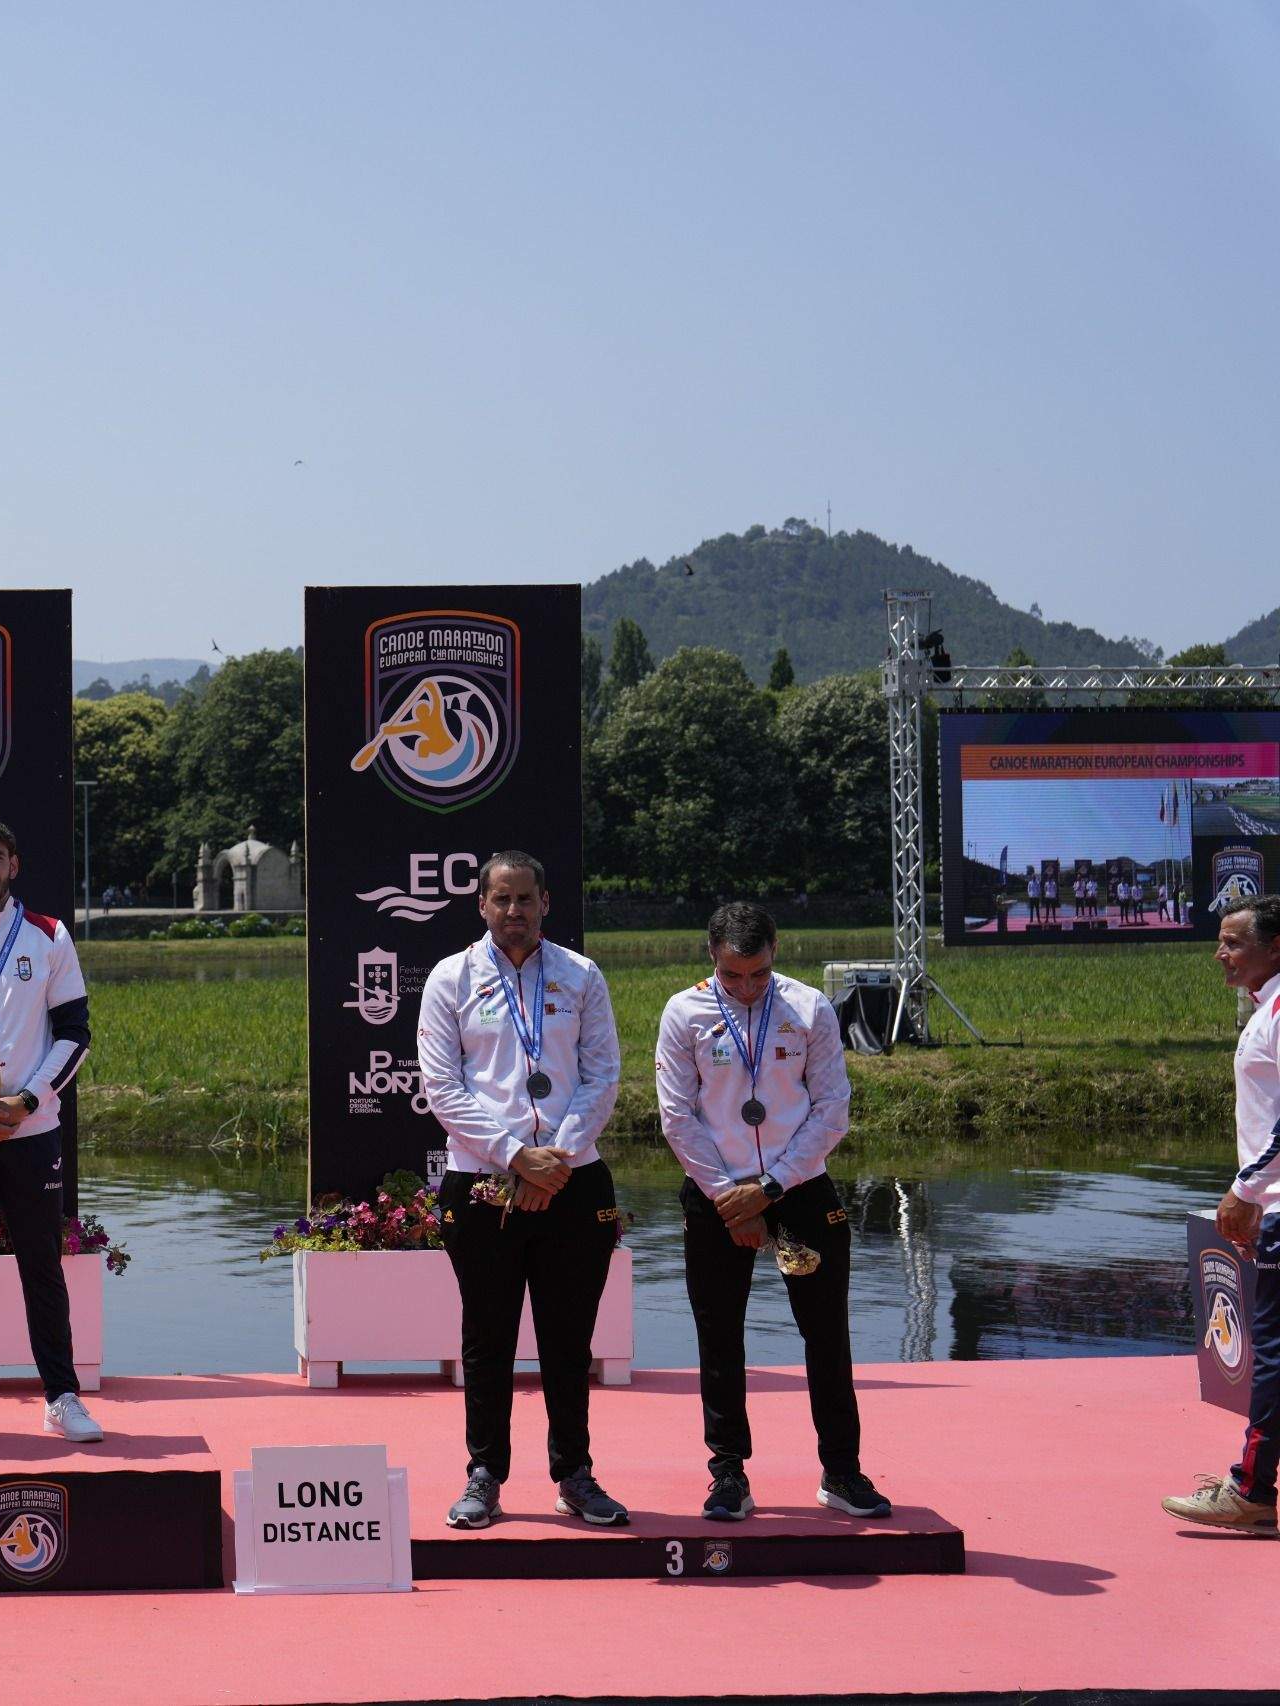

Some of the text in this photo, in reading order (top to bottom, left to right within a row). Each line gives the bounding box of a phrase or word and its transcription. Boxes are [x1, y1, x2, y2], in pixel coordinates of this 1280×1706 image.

[379, 629, 504, 654] CANOE MARATHON
[379, 648, 504, 668] EUROPEAN CHAMPIONSHIPS
[990, 754, 1245, 770] CANOE MARATHON EUROPEAN CHAMPIONSHIPS
[410, 853, 497, 895] EC
[400, 965, 433, 974] Federa
[400, 985, 423, 993] CANO
[349, 1071, 425, 1094] NORT
[827, 1209, 847, 1224] ES
[22, 1490, 60, 1503] MARATHON
[278, 1481, 363, 1508] LONG
[263, 1521, 381, 1543] DISTANCE
[666, 1541, 684, 1576] 3
